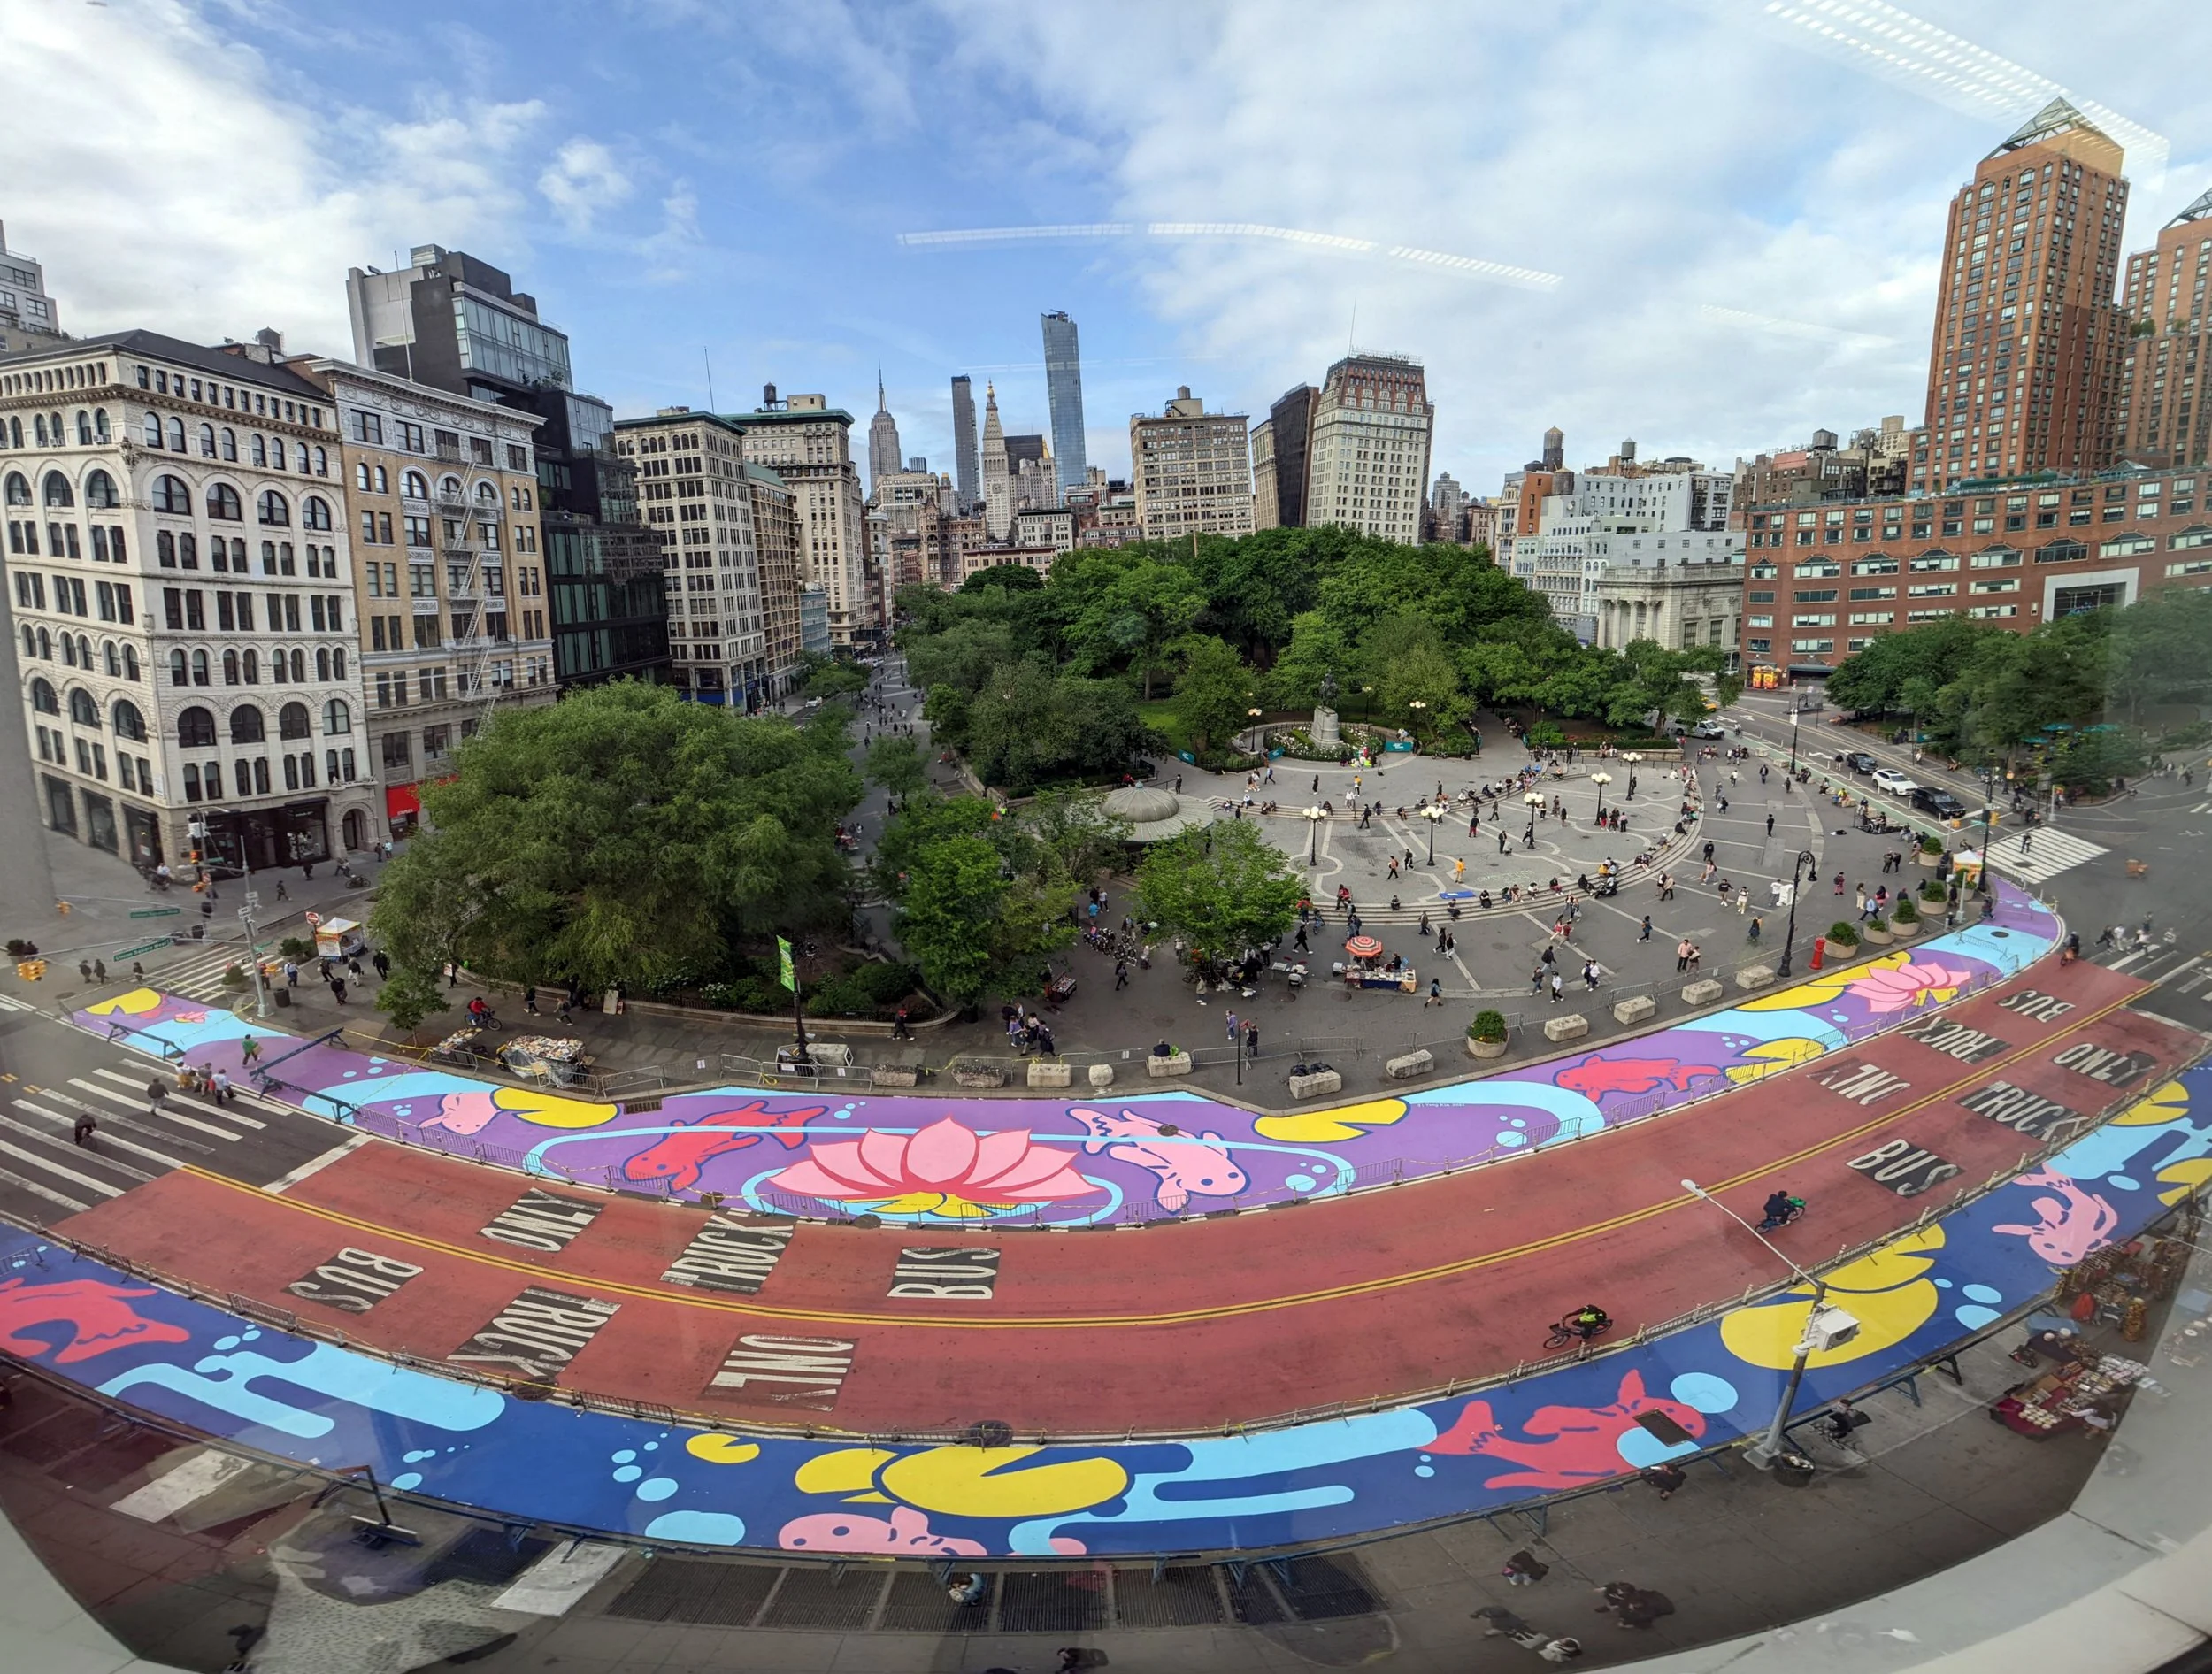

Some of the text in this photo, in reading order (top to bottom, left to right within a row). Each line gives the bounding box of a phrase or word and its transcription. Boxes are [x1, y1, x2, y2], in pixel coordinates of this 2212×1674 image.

[1998, 989, 2077, 1023] BUS
[1805, 1064, 1911, 1106] ONLY
[2053, 1043, 2155, 1086] ONLY
[1958, 1080, 2092, 1142] TRUCK
[1846, 1139, 1958, 1197] BUS
[480, 1186, 602, 1253] ONLY
[288, 1248, 424, 1311] BUS
[660, 1215, 795, 1293] TRUCK
[887, 1247, 1001, 1299] BUS
[447, 1288, 621, 1377] TRUCK
[705, 1334, 854, 1411] ONLY
